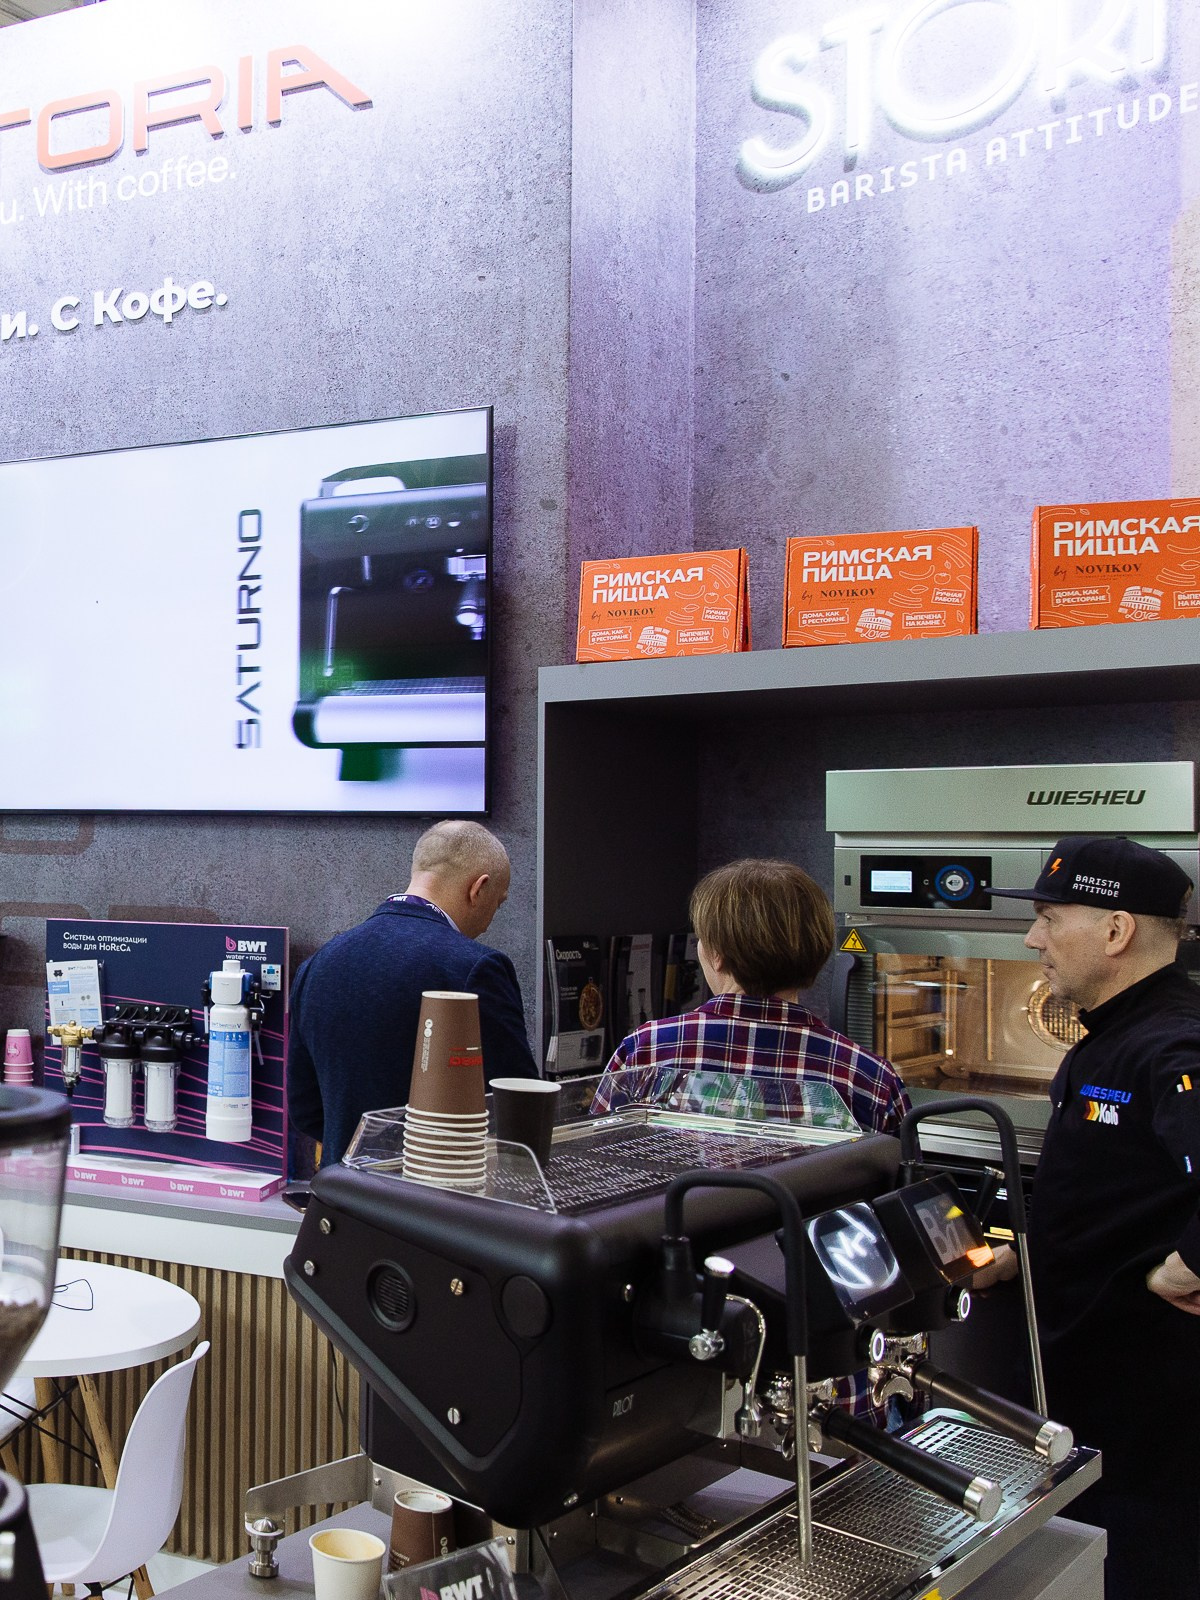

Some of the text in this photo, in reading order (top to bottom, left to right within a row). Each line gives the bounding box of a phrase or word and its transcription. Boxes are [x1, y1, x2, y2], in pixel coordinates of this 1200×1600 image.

[806, 82, 1198, 213] BARISTA ATTITUDE
[32, 174, 108, 218] With
[116, 153, 237, 201] coffee.
[93, 276, 229, 327] Кофе.
[1054, 516, 1200, 539] РИМСКАЯ
[1054, 536, 1160, 557] ПИЦЦА
[803, 545, 933, 567] РИМСКАЯ
[593, 566, 704, 589] РИМСКАЯ
[802, 564, 893, 583] ПИЦЦА
[1075, 563, 1142, 575] NOVIKOV
[592, 585, 670, 604] ПИЦЦА
[820, 588, 877, 598] NOVIKOV
[1062, 595, 1106, 603] РЕСТОРАНЕ
[1177, 593, 1200, 601] ВЫПЕ
[606, 607, 656, 618] NOVIKOV
[234, 508, 264, 750] SATURNO
[1026, 789, 1147, 806] WIESHEU
[1072, 882, 1120, 898] ATTITUDE
[1075, 874, 1121, 889] BARISTA
[237, 940, 268, 953] BWT
[555, 949, 582, 962] Скорость
[1080, 1083, 1132, 1104] WIESHEU
[1098, 1103, 1119, 1125] Kolb
[81, 1172, 97, 1181] BWT
[128, 1178, 145, 1186] BWT
[176, 1183, 194, 1192] BWT
[227, 1189, 245, 1198] BWT
[440, 1574, 484, 1600] BWT
